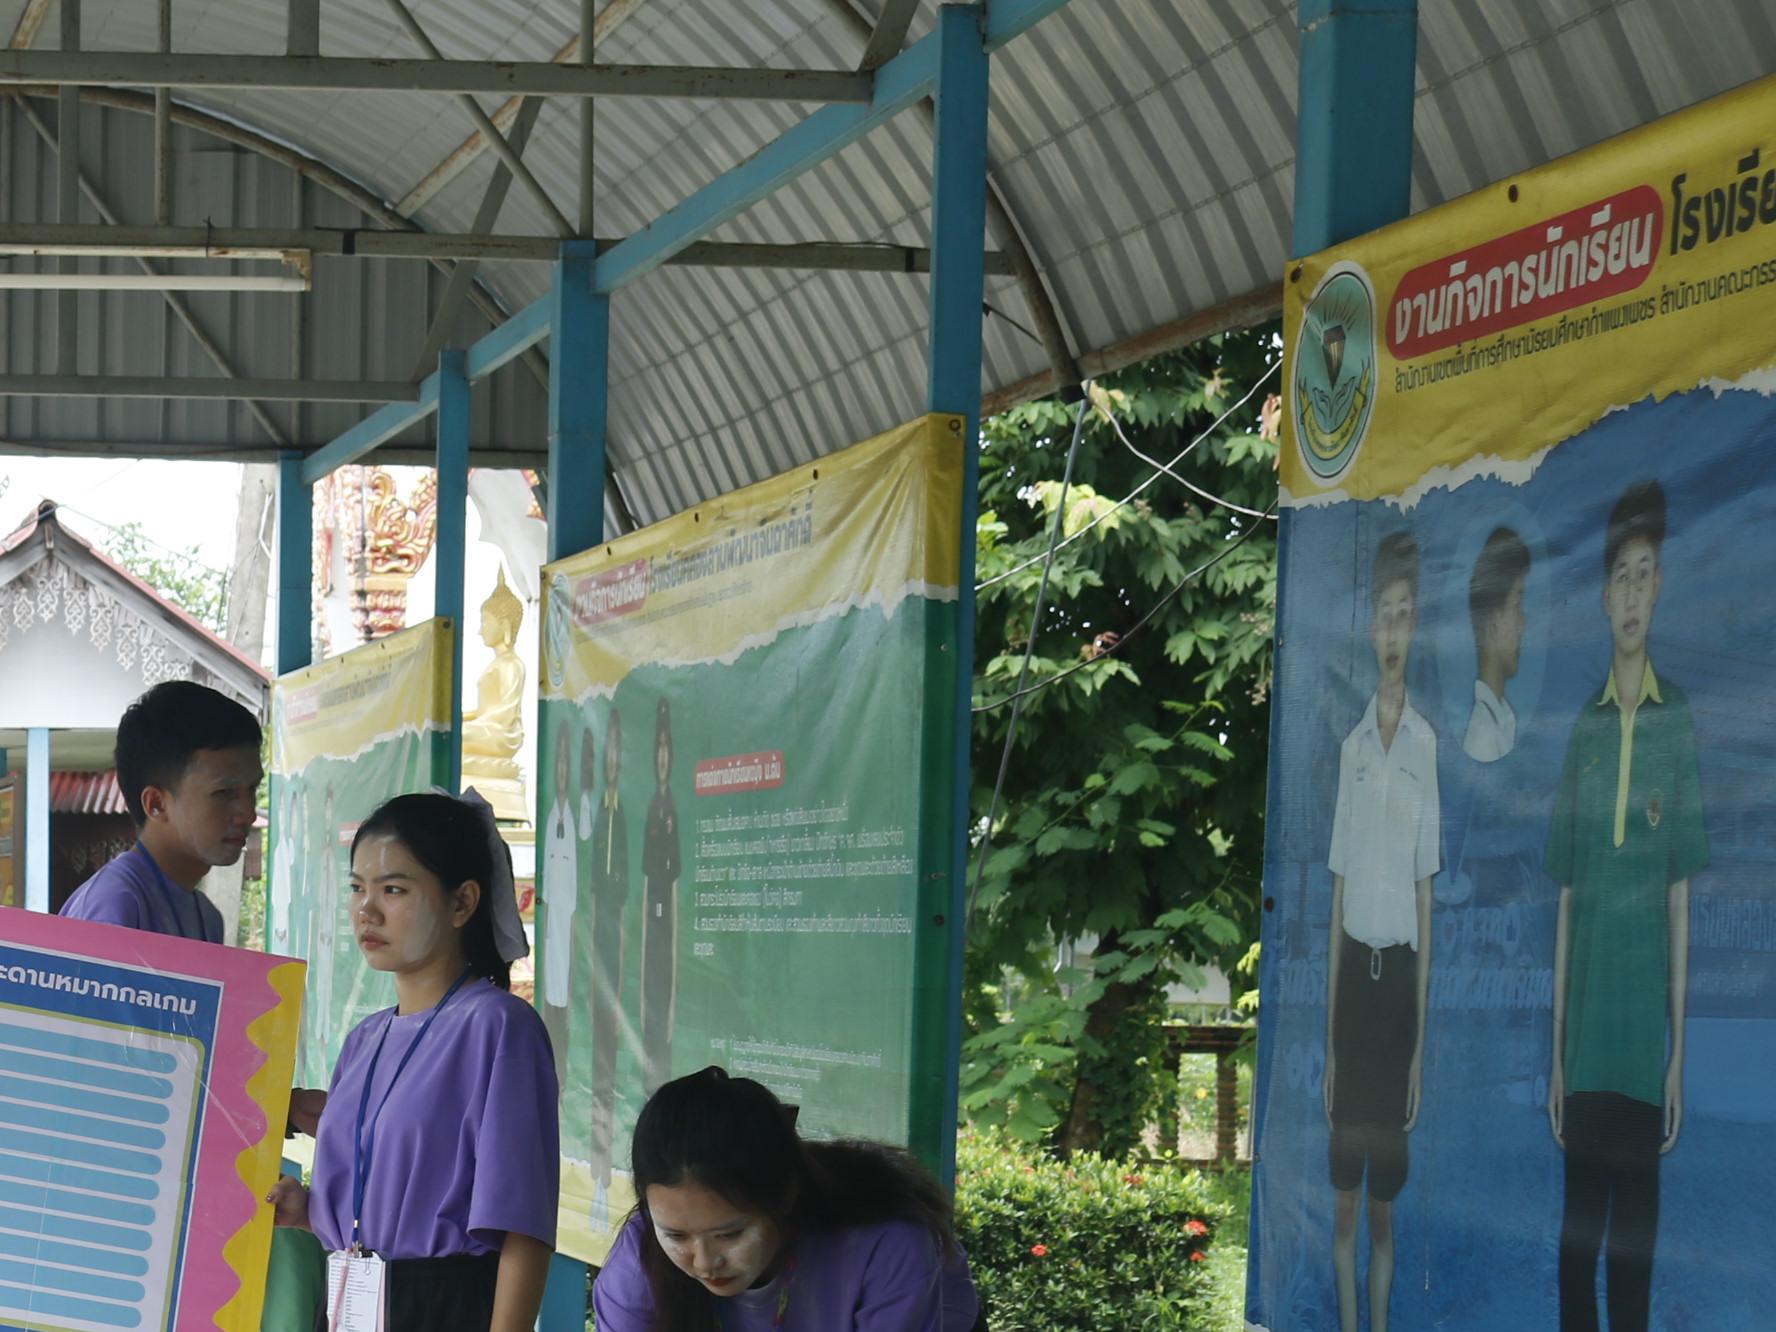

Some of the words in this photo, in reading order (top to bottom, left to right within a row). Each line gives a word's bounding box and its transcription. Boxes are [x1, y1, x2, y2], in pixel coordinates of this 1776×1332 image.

[1393, 203, 1654, 344] งานกิจการนักเรียน
